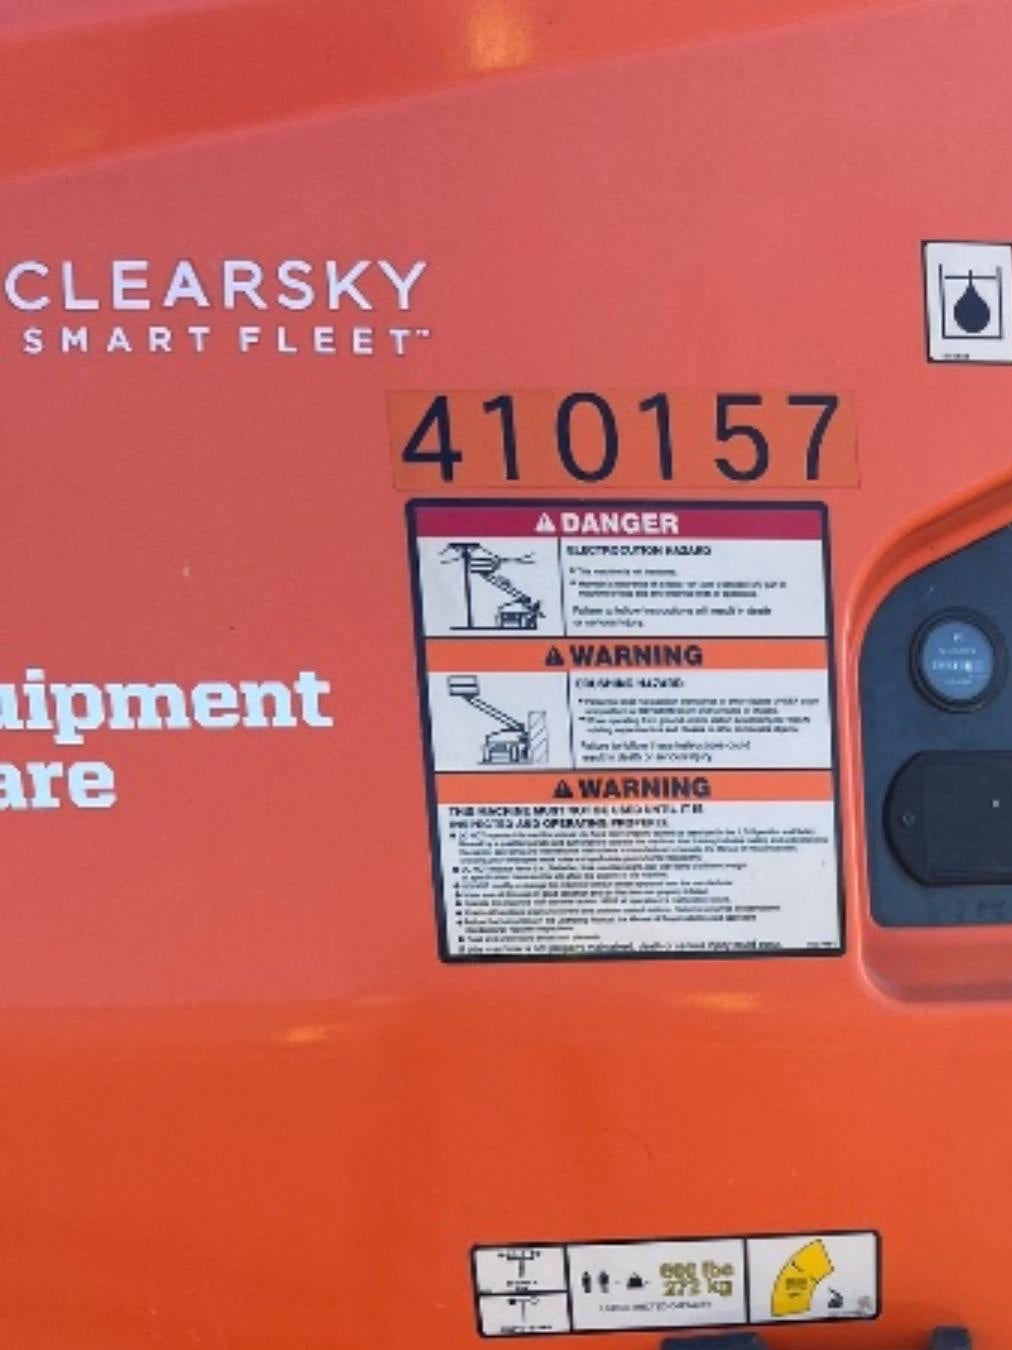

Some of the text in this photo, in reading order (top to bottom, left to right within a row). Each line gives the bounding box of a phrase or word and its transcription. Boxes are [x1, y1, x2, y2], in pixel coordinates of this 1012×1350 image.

[4, 260, 427, 311] CLEARSKY
[23, 325, 211, 354] SMART
[401, 391, 839, 482] 410157
[561, 512, 679, 535] DANGER
[570, 644, 703, 666] WARNING
[578, 776, 711, 799] WARNING
